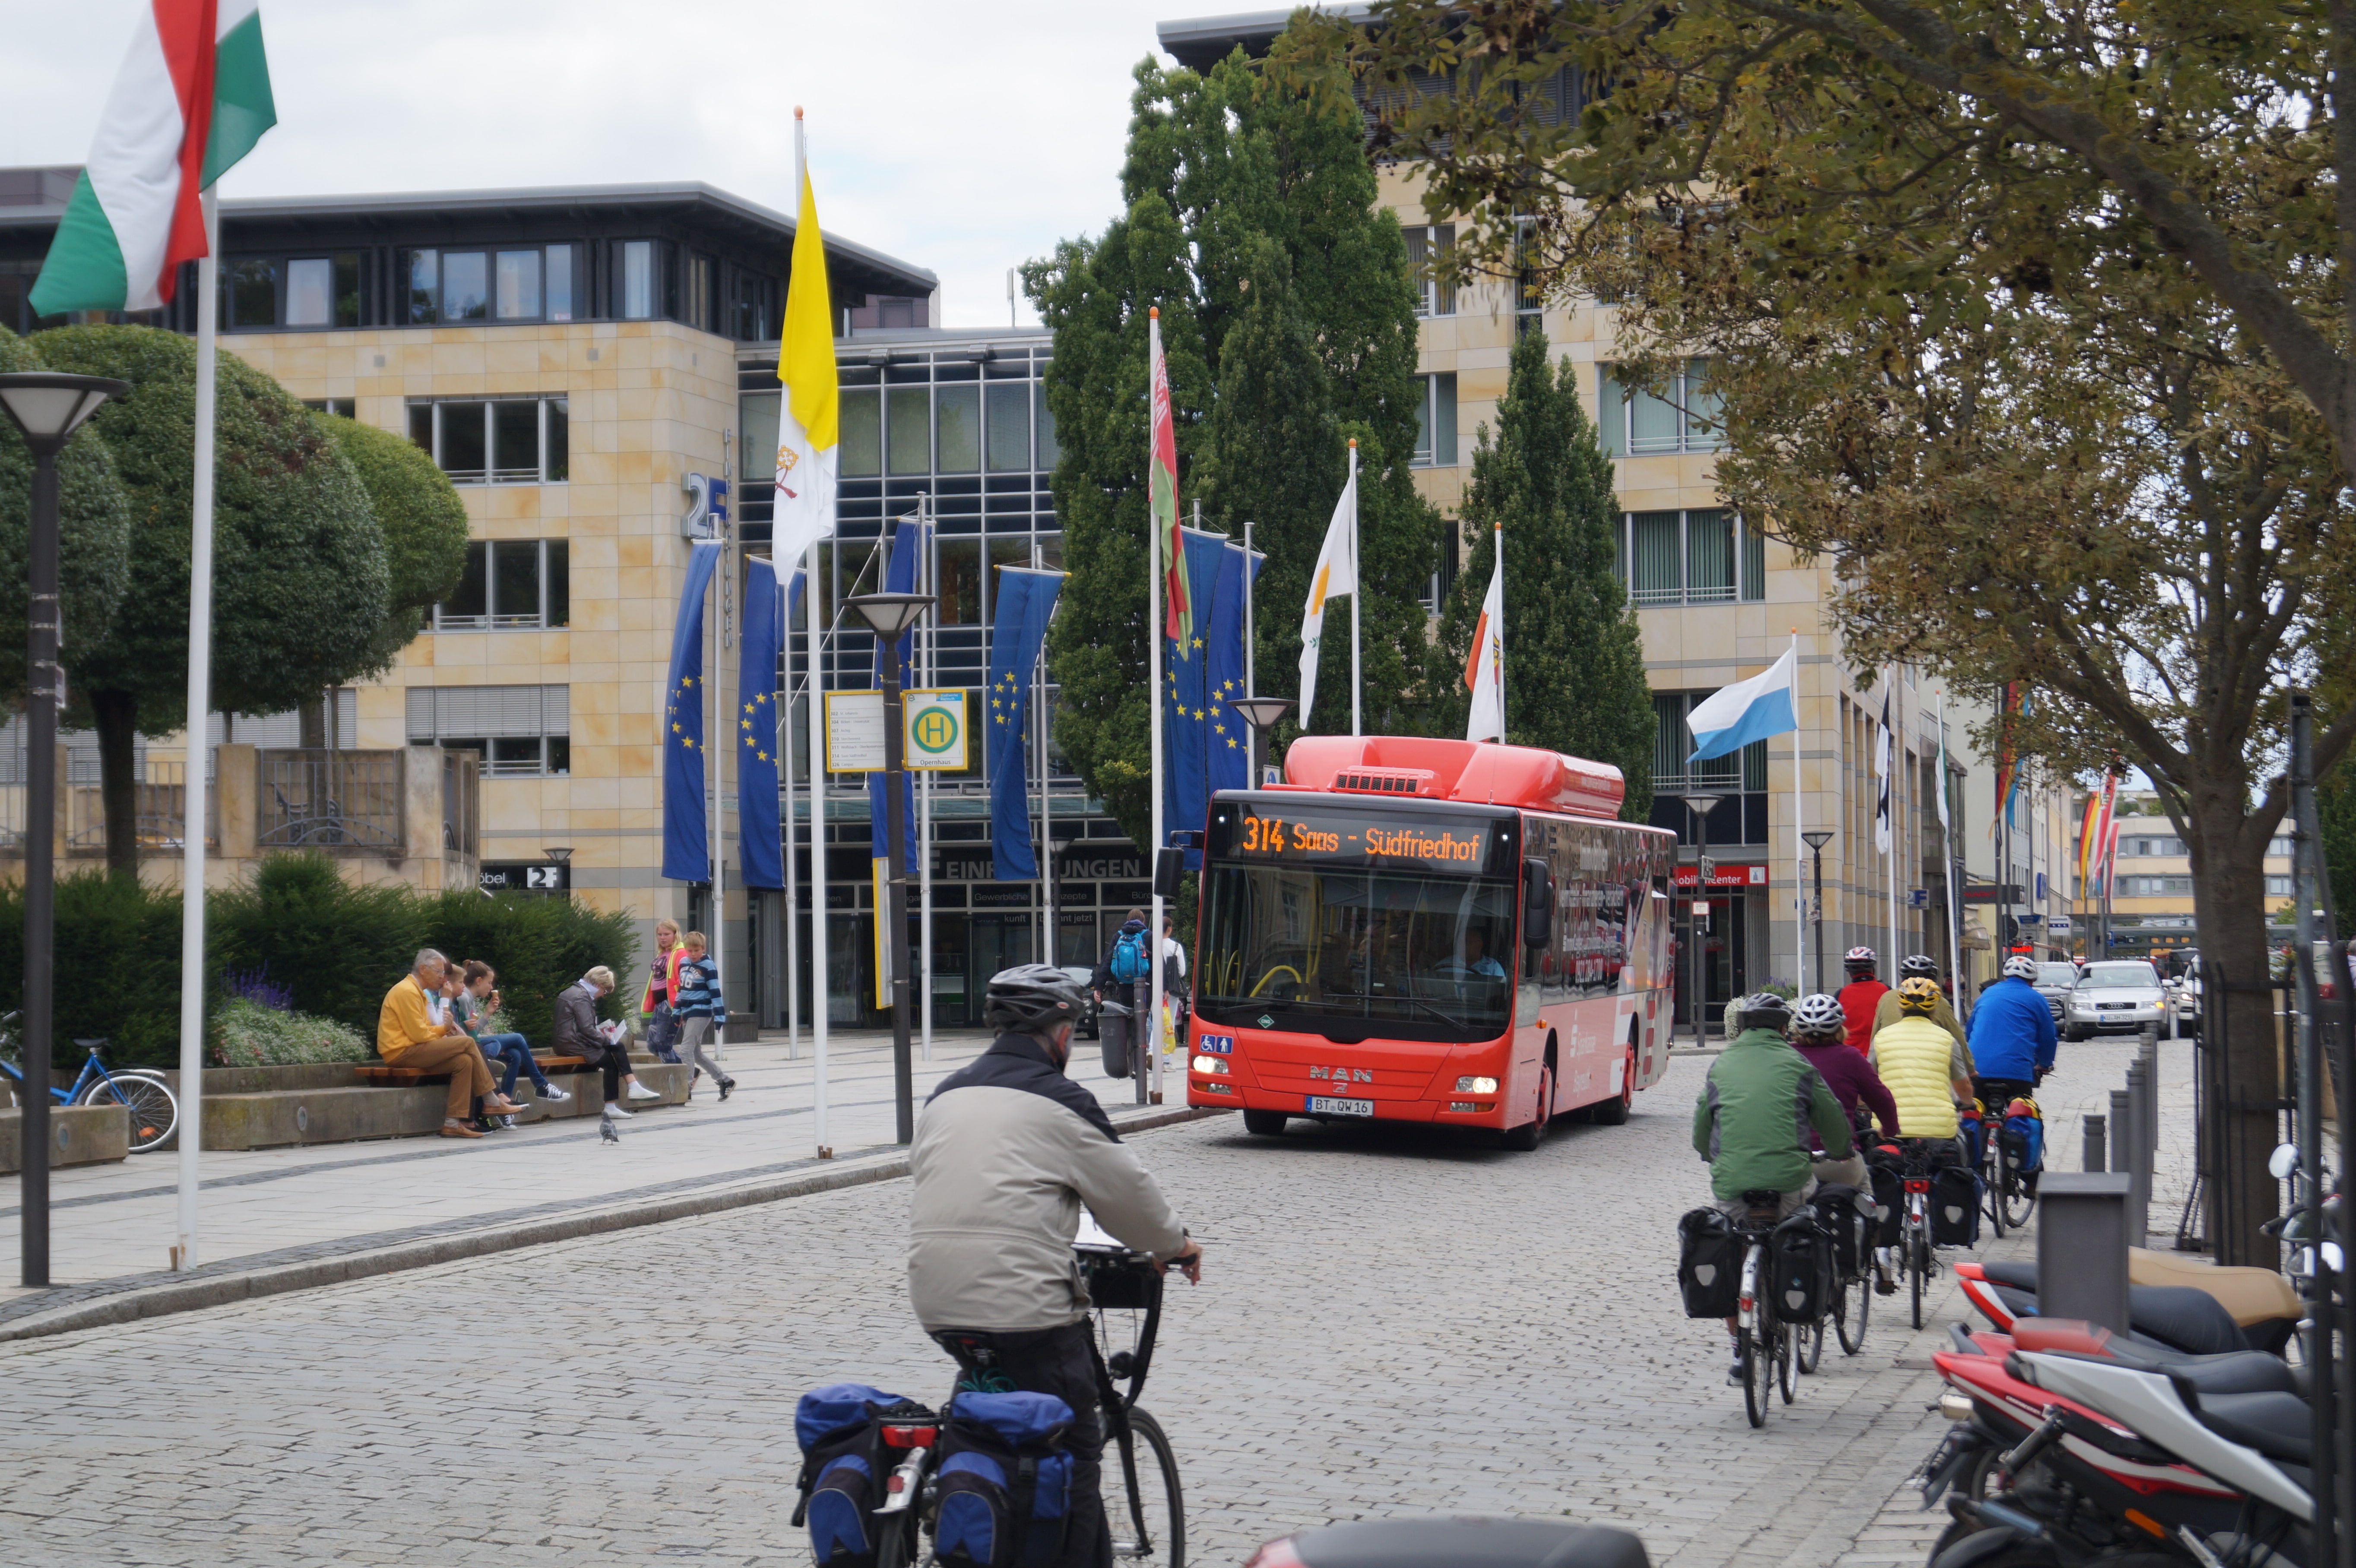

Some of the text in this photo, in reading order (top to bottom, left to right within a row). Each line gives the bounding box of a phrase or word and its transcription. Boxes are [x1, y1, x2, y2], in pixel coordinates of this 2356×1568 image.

[925, 717, 944, 743] H
[920, 759, 951, 767] Opernhaus
[1243, 816, 1285, 852] 314
[1292, 823, 1339, 851] Saas
[1365, 828, 1480, 861] Südfriedhof
[974, 893, 1028, 901] Gewerbliche
[1074, 914, 1092, 923] jetzt
[1309, 1065, 1372, 1083] MAN
[1316, 1099, 1330, 1110] BT
[1337, 1101, 1352, 1112] QW
[1354, 1102, 1368, 1113] 16
